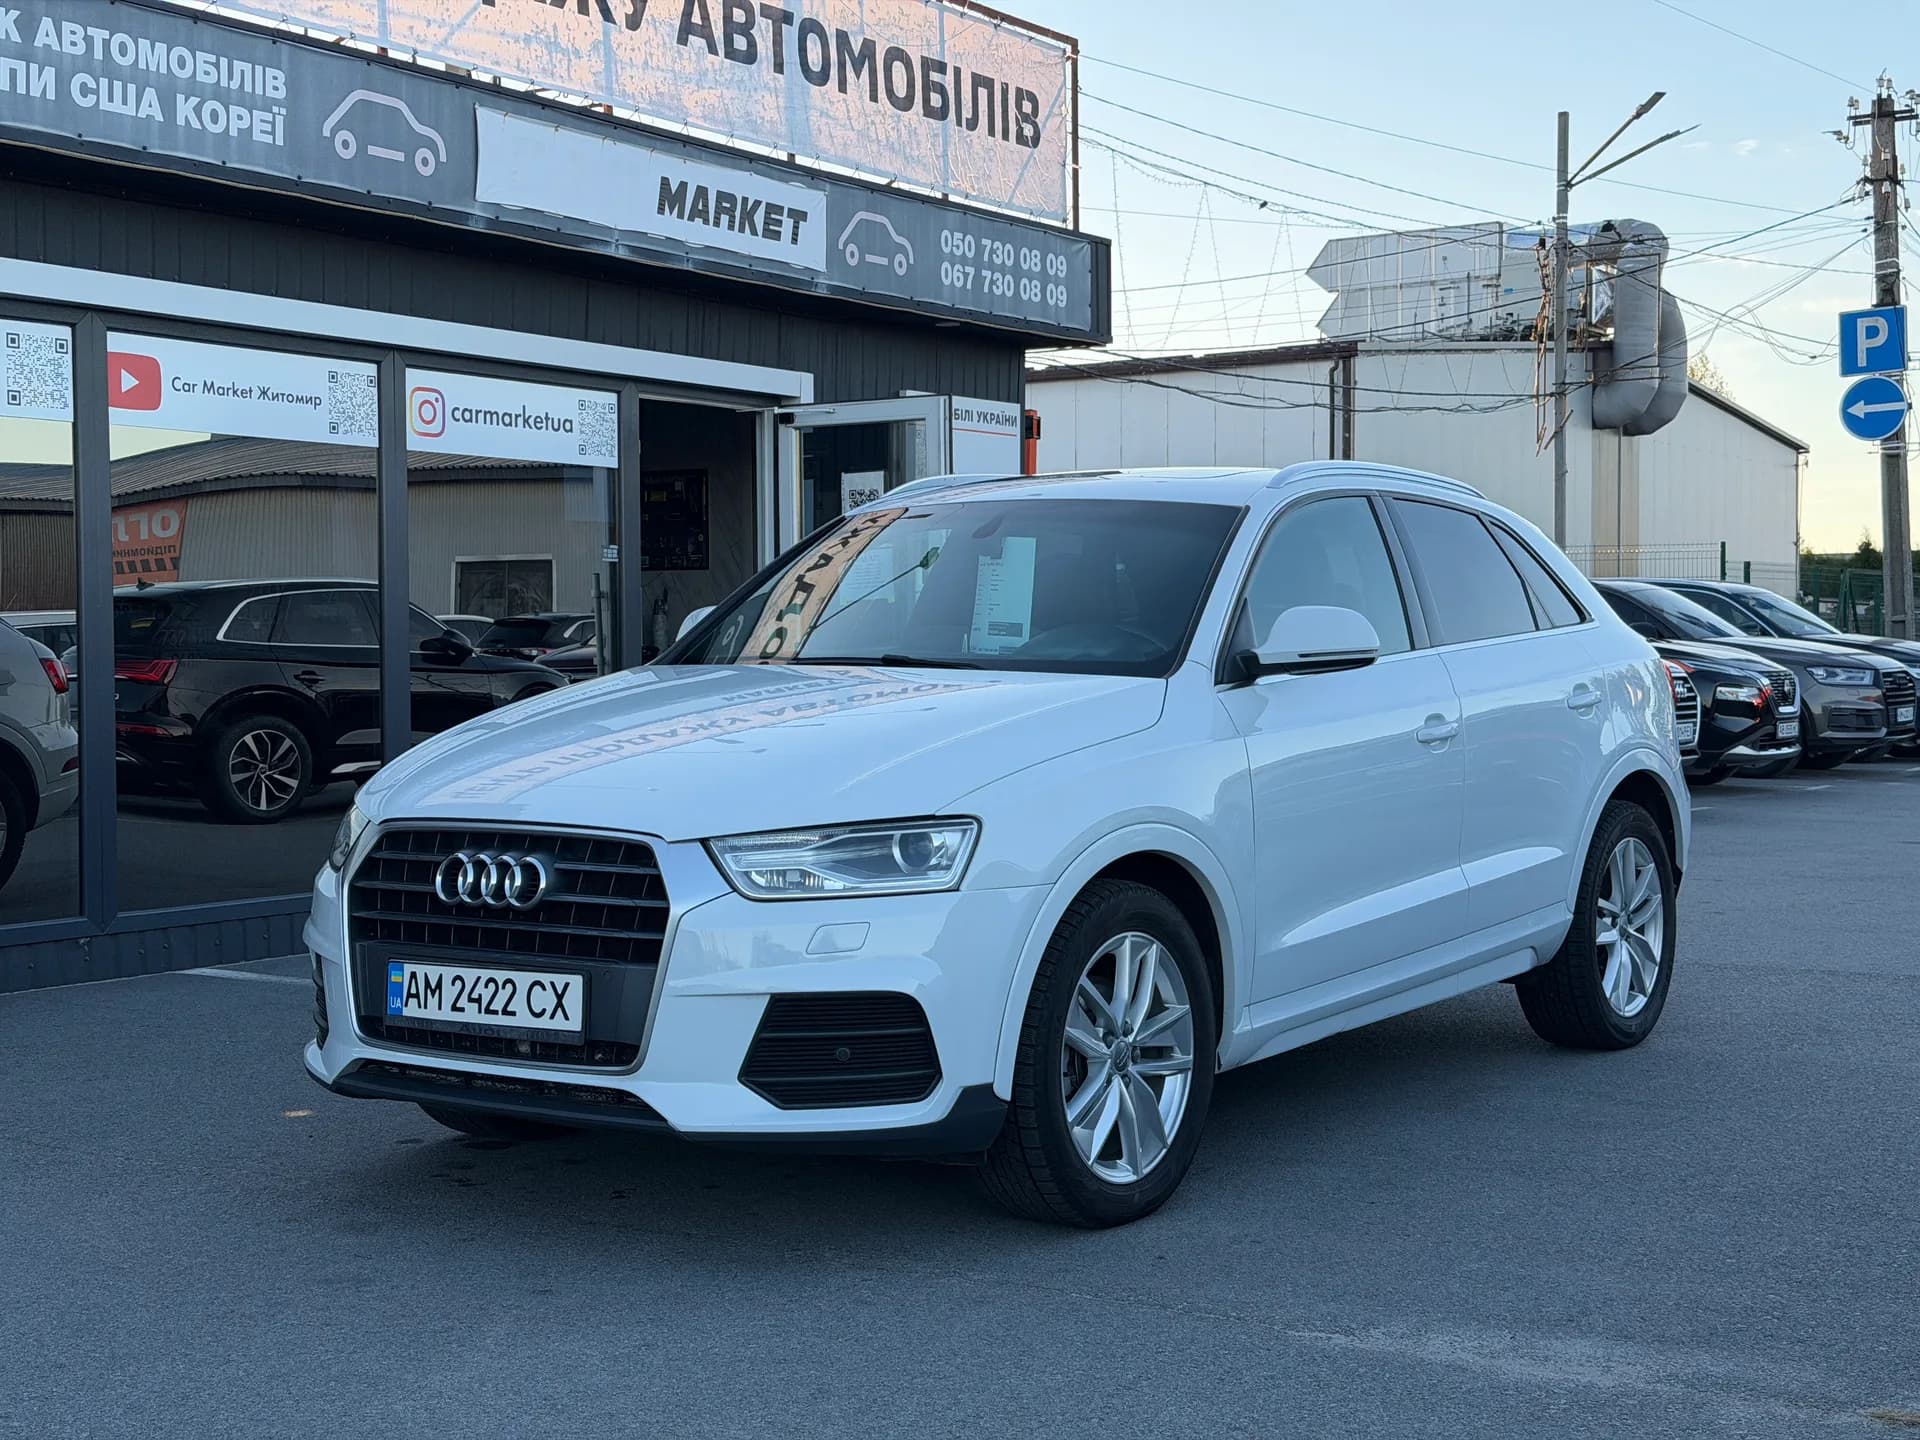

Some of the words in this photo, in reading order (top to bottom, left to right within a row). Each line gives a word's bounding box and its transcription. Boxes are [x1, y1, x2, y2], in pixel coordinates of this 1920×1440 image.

[34, 17, 287, 99] АВТОМОБІЛІВ
[676, 0, 1042, 149] АВТОМОБІЛІВ
[0, 57, 56, 101] ПИ
[70, 72, 164, 122] США
[176, 94, 287, 146] КОРЕЇ
[657, 176, 808, 245] MARKET
[940, 229, 975, 258] 050
[981, 238, 1015, 267] 730
[1020, 247, 1041, 272] 08
[1046, 253, 1067, 278] 09
[940, 261, 975, 290] 067
[981, 269, 1015, 297] 730
[1020, 278, 1041, 303] 08
[1046, 283, 1067, 308] 09
[1857, 316, 1889, 368] P
[171, 376, 198, 393] Car
[202, 379, 253, 400] Market
[256, 385, 322, 410] Житомир
[951, 407, 973, 422] БІЛІ
[976, 410, 1017, 428] УКРАЇНИ
[451, 405, 574, 433] carmarketua
[390, 996, 402, 1009] UA
[404, 971, 443, 1011] AM
[451, 975, 517, 1017] 2422
[526, 980, 571, 1021] CX
